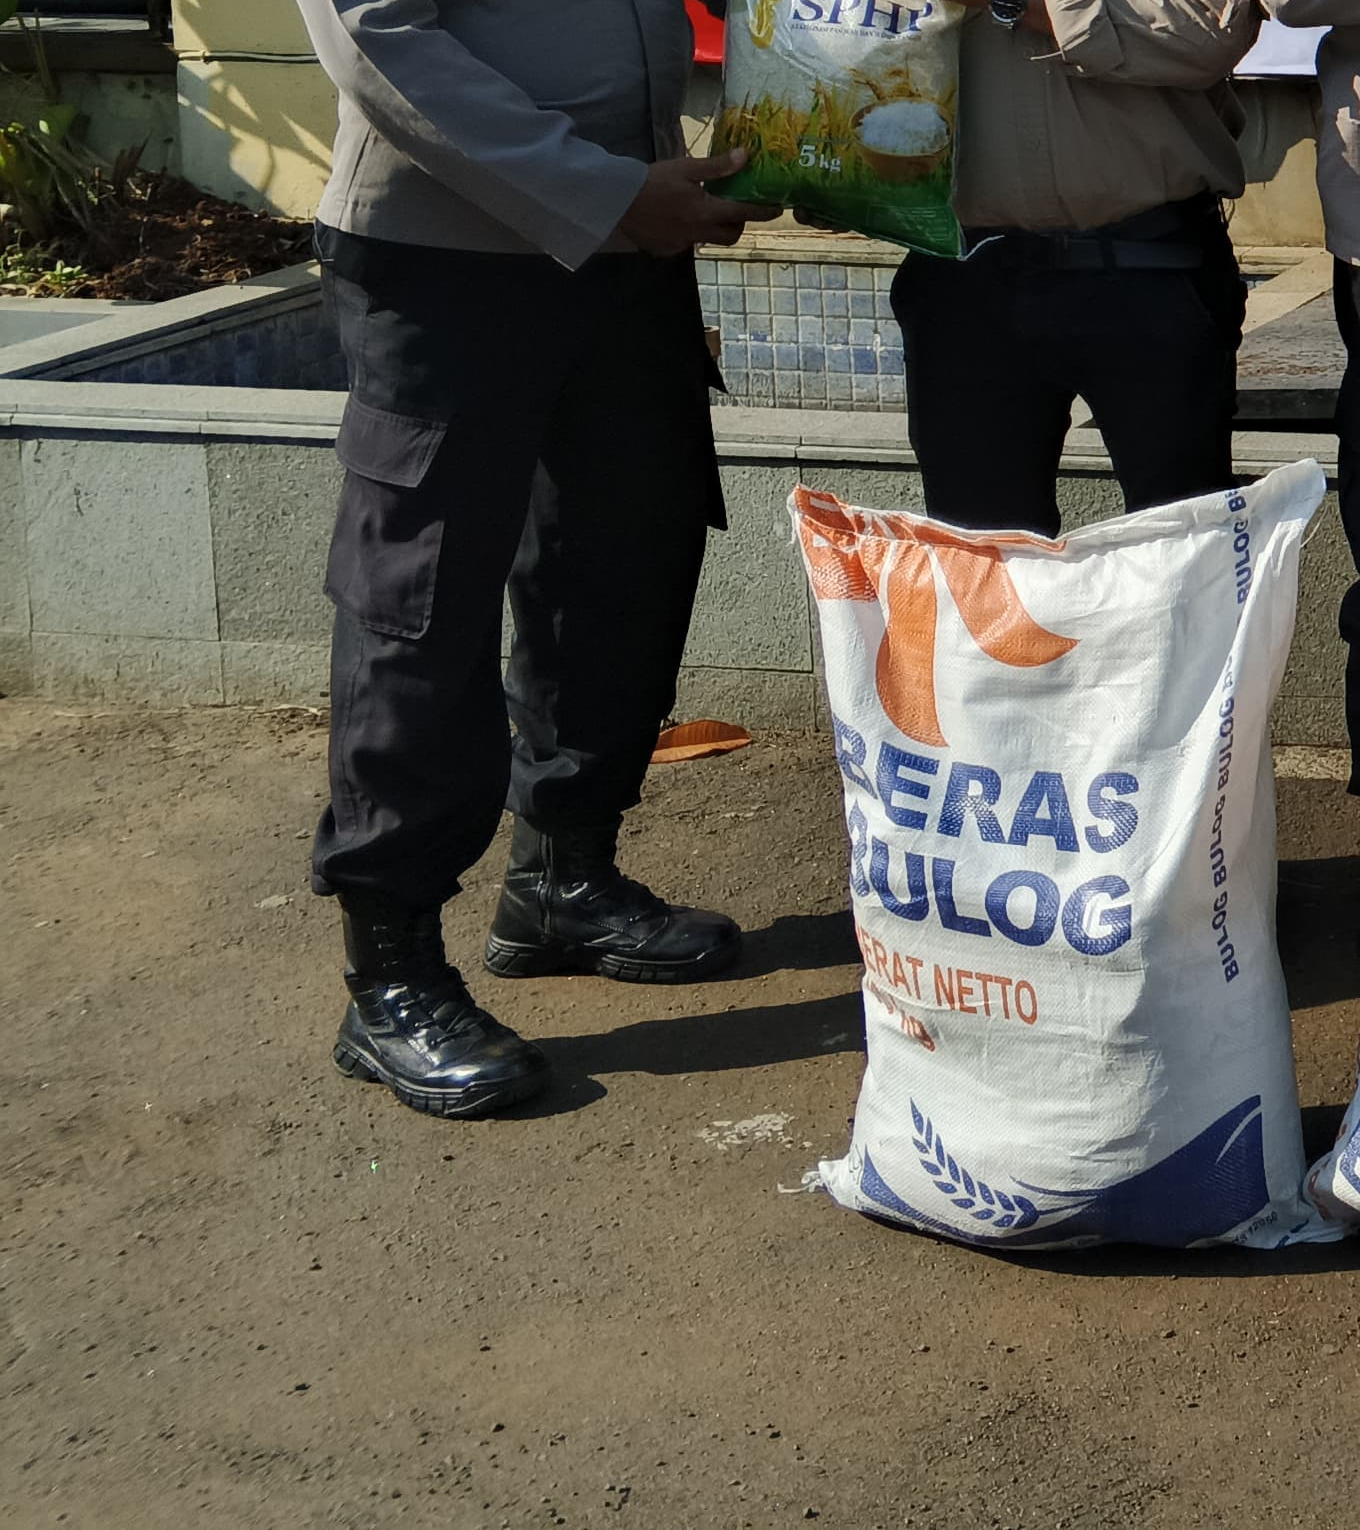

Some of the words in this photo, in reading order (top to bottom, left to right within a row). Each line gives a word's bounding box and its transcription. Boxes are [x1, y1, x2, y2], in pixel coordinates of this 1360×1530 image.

[798, 145, 817, 167] 5
[819, 155, 841, 172] kg
[1232, 518, 1253, 605] BULOG
[832, 713, 1140, 854] BERAS
[1217, 696, 1236, 792] BULOG
[849, 798, 1133, 956] BULOG
[1209, 794, 1228, 889] BULOG
[1211, 891, 1240, 984] BULOG
[933, 964, 1038, 1026] NETTO
